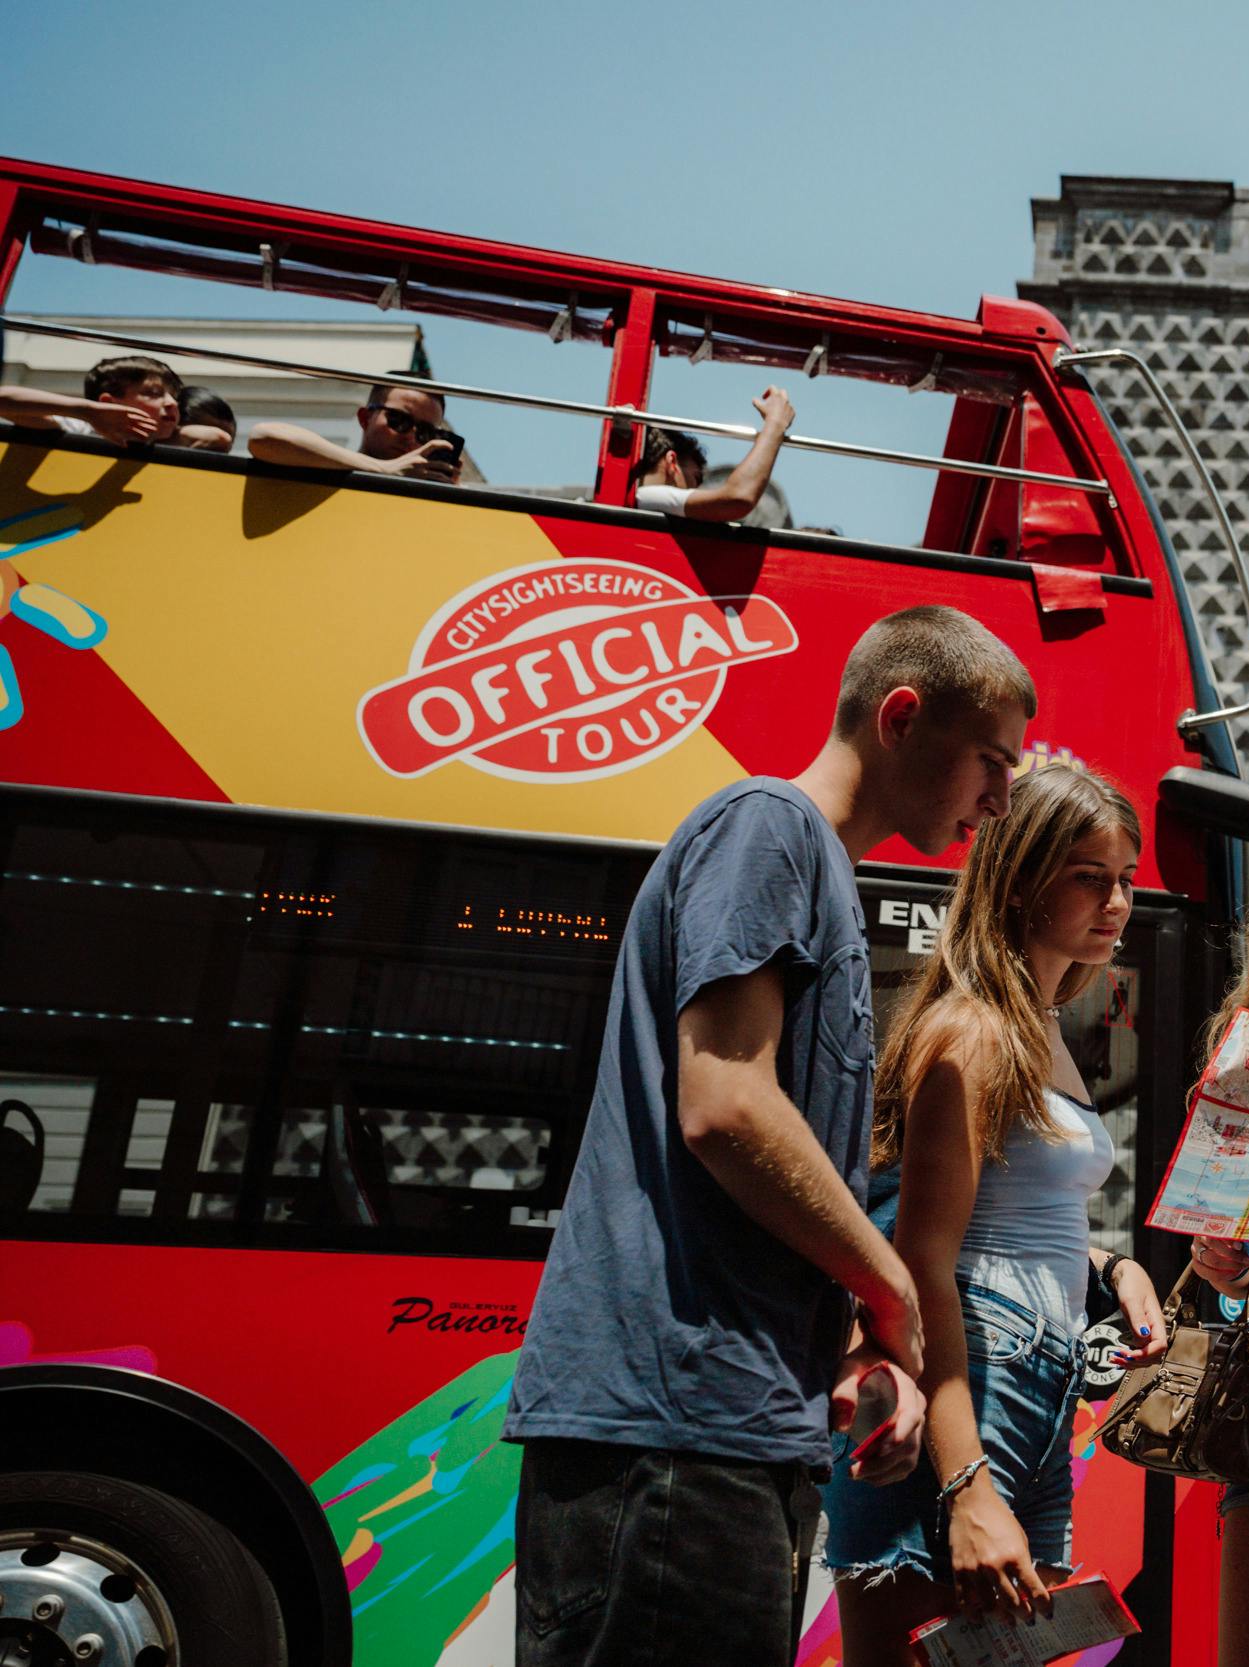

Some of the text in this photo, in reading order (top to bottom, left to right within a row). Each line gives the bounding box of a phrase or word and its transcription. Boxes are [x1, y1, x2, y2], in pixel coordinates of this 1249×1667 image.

[447, 572, 663, 651] CITYSIGHTSEEING
[407, 606, 774, 747] OFFICIAL
[540, 687, 701, 763] TOUR
[878, 899, 948, 929] EN
[1084, 1327, 1119, 1345] FRE
[1084, 1368, 1117, 1383] ZONE
